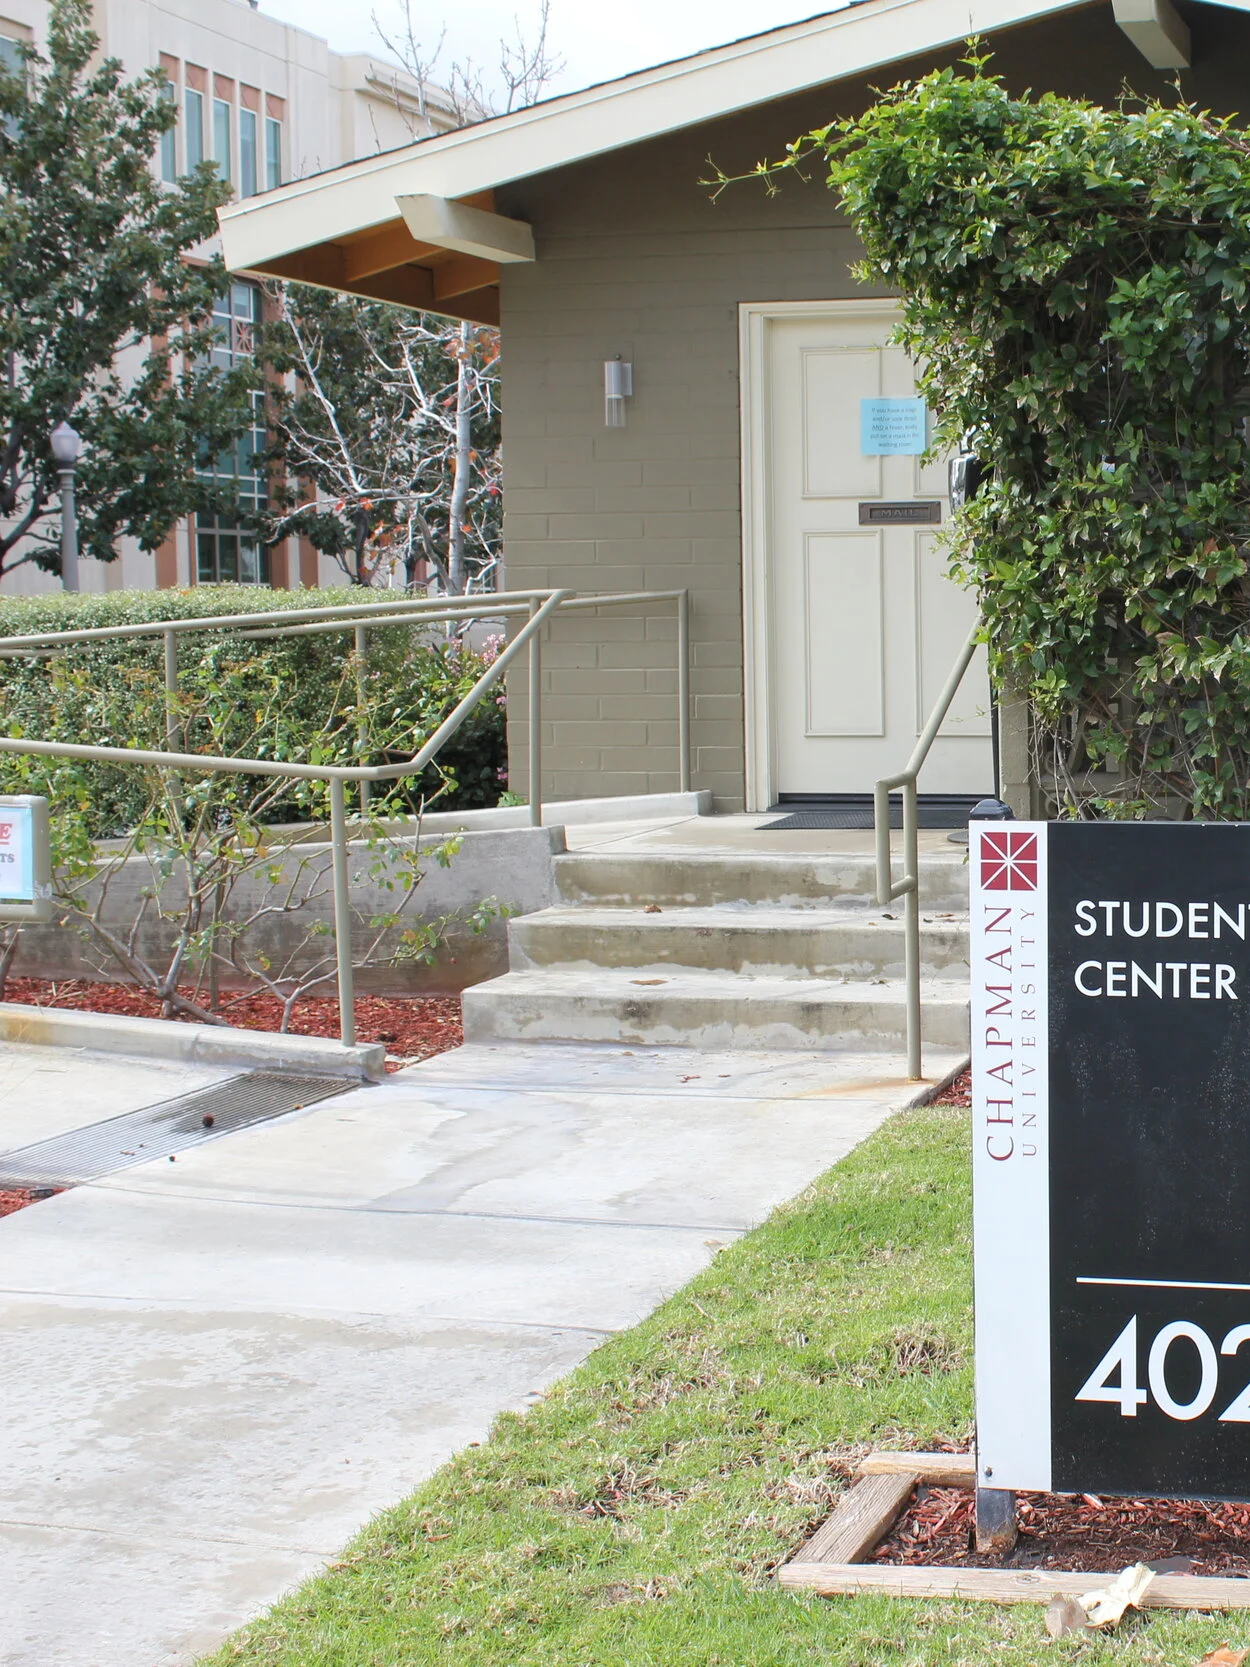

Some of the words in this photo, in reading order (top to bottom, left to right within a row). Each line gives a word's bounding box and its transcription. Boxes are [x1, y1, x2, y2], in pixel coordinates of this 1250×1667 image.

[881, 509, 917, 518] MAIL
[984, 905, 1015, 1162] CHAPMAN
[1020, 907, 1038, 1157] UNIVERSITY
[1074, 960, 1239, 1000] CENTER
